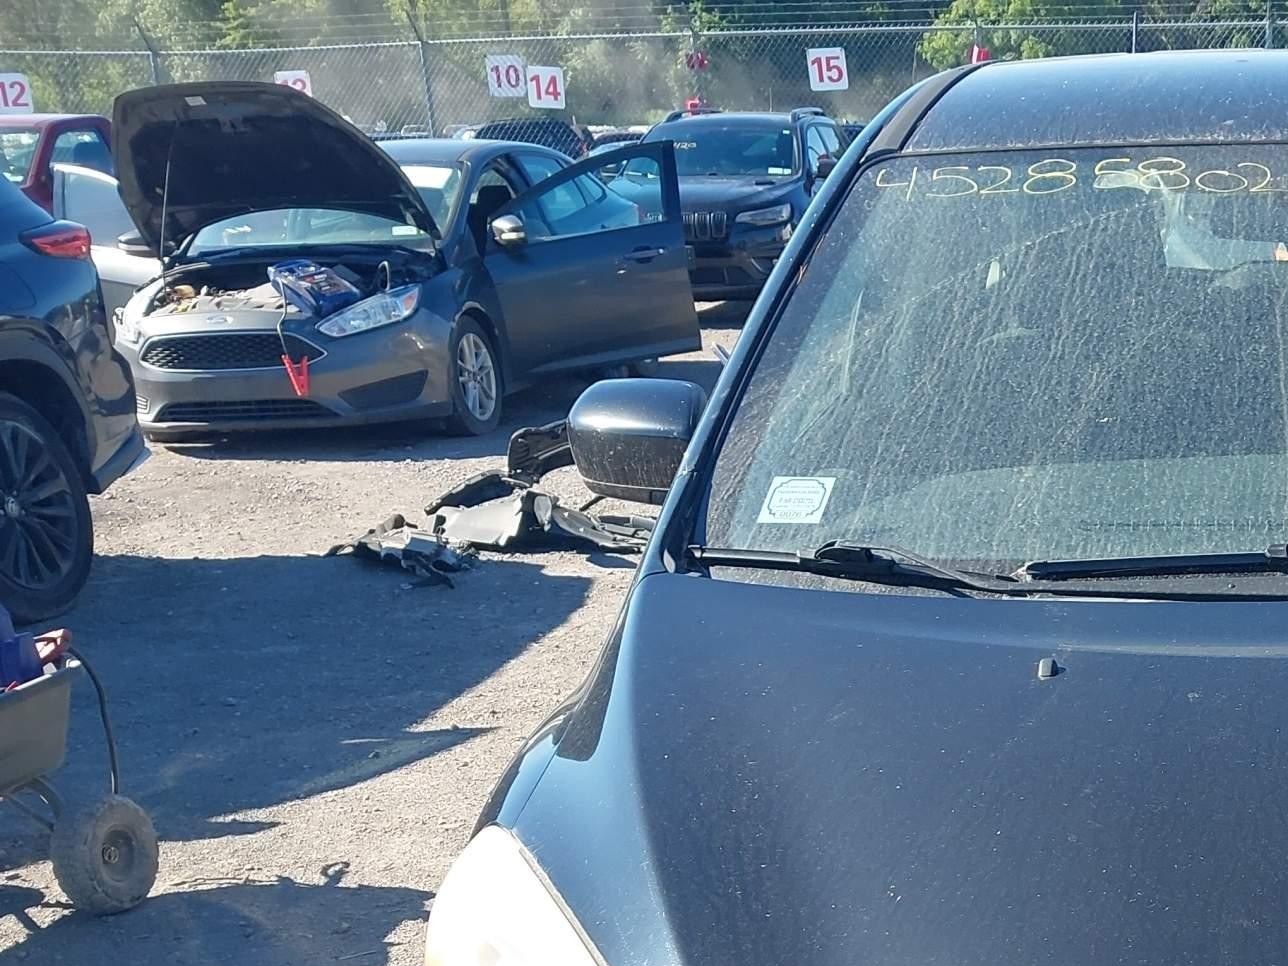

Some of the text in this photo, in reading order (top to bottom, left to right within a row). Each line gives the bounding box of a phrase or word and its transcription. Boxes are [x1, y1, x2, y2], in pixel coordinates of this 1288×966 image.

[490, 64, 520, 88] 10
[811, 55, 844, 83] 15
[529, 74, 561, 101] 14
